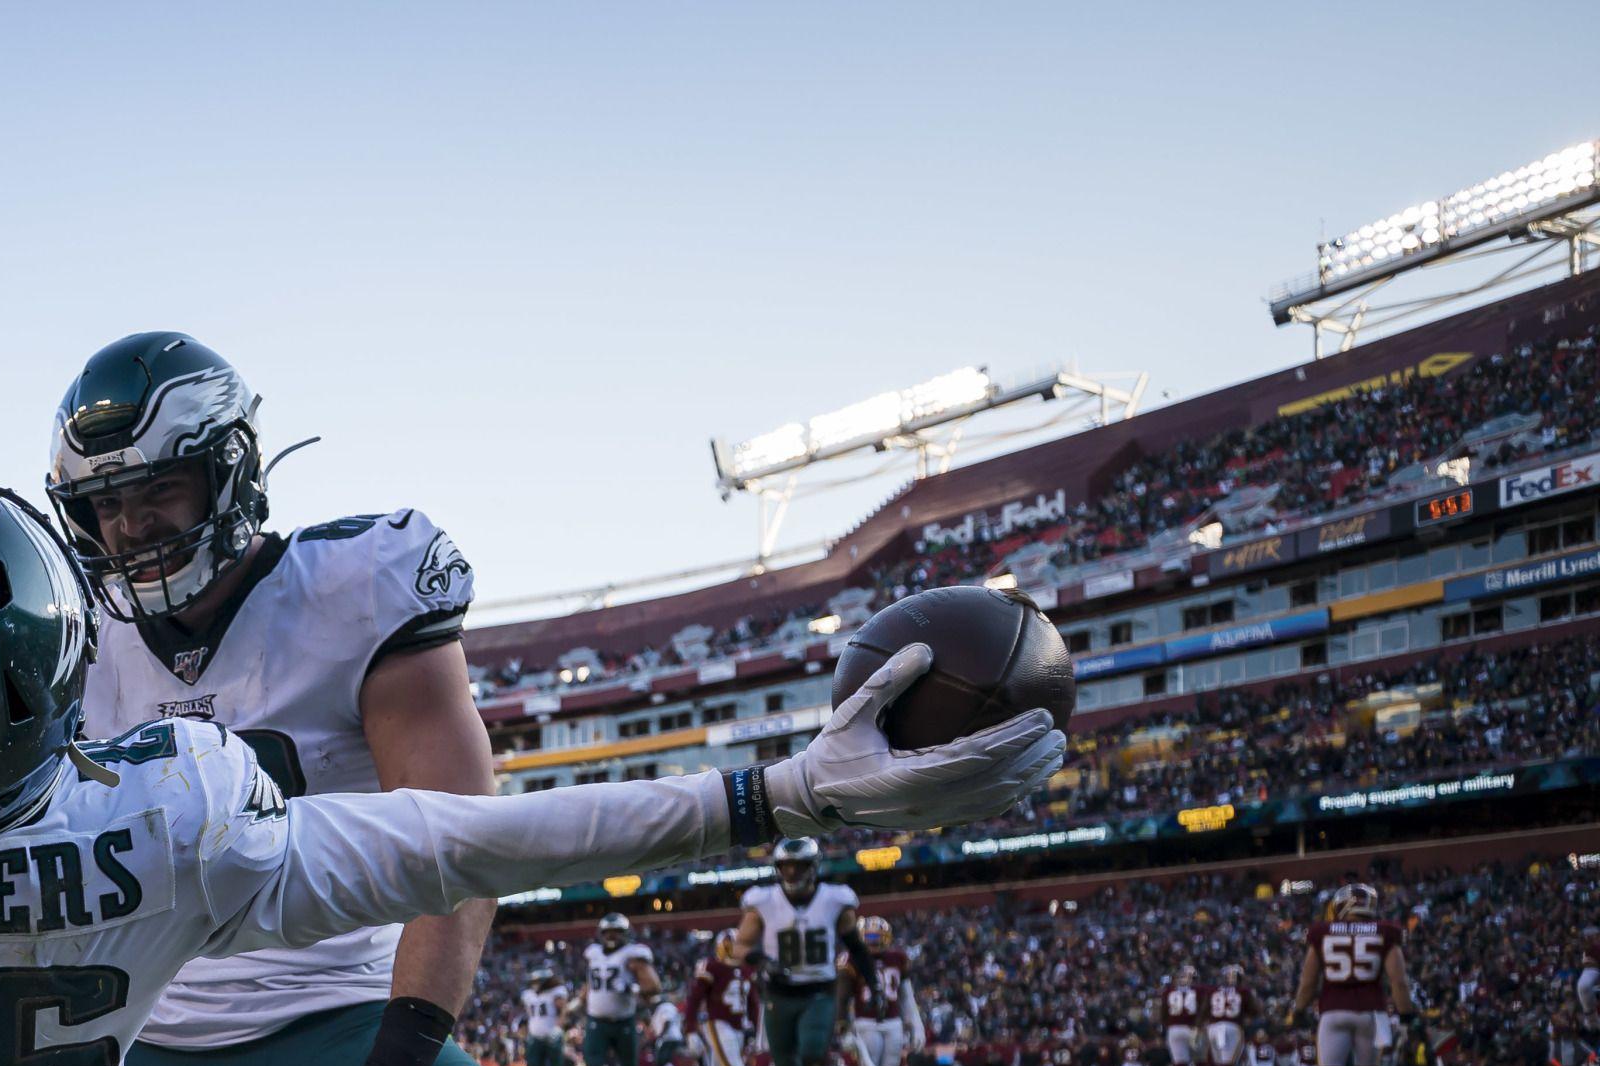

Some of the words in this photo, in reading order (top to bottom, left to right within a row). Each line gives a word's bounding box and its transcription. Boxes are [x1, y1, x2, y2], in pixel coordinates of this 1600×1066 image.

[1506, 464, 1593, 501] FedEx
[1507, 558, 1557, 587] Merrill
[158, 694, 217, 720] EAGLES
[731, 714, 794, 740] GEICO
[1320, 791, 1367, 811] Proudly
[1368, 783, 1435, 805] supporting
[1437, 781, 1461, 795] our
[1462, 773, 1515, 793] military
[777, 927, 828, 966] 86
[1322, 934, 1383, 981] 55
